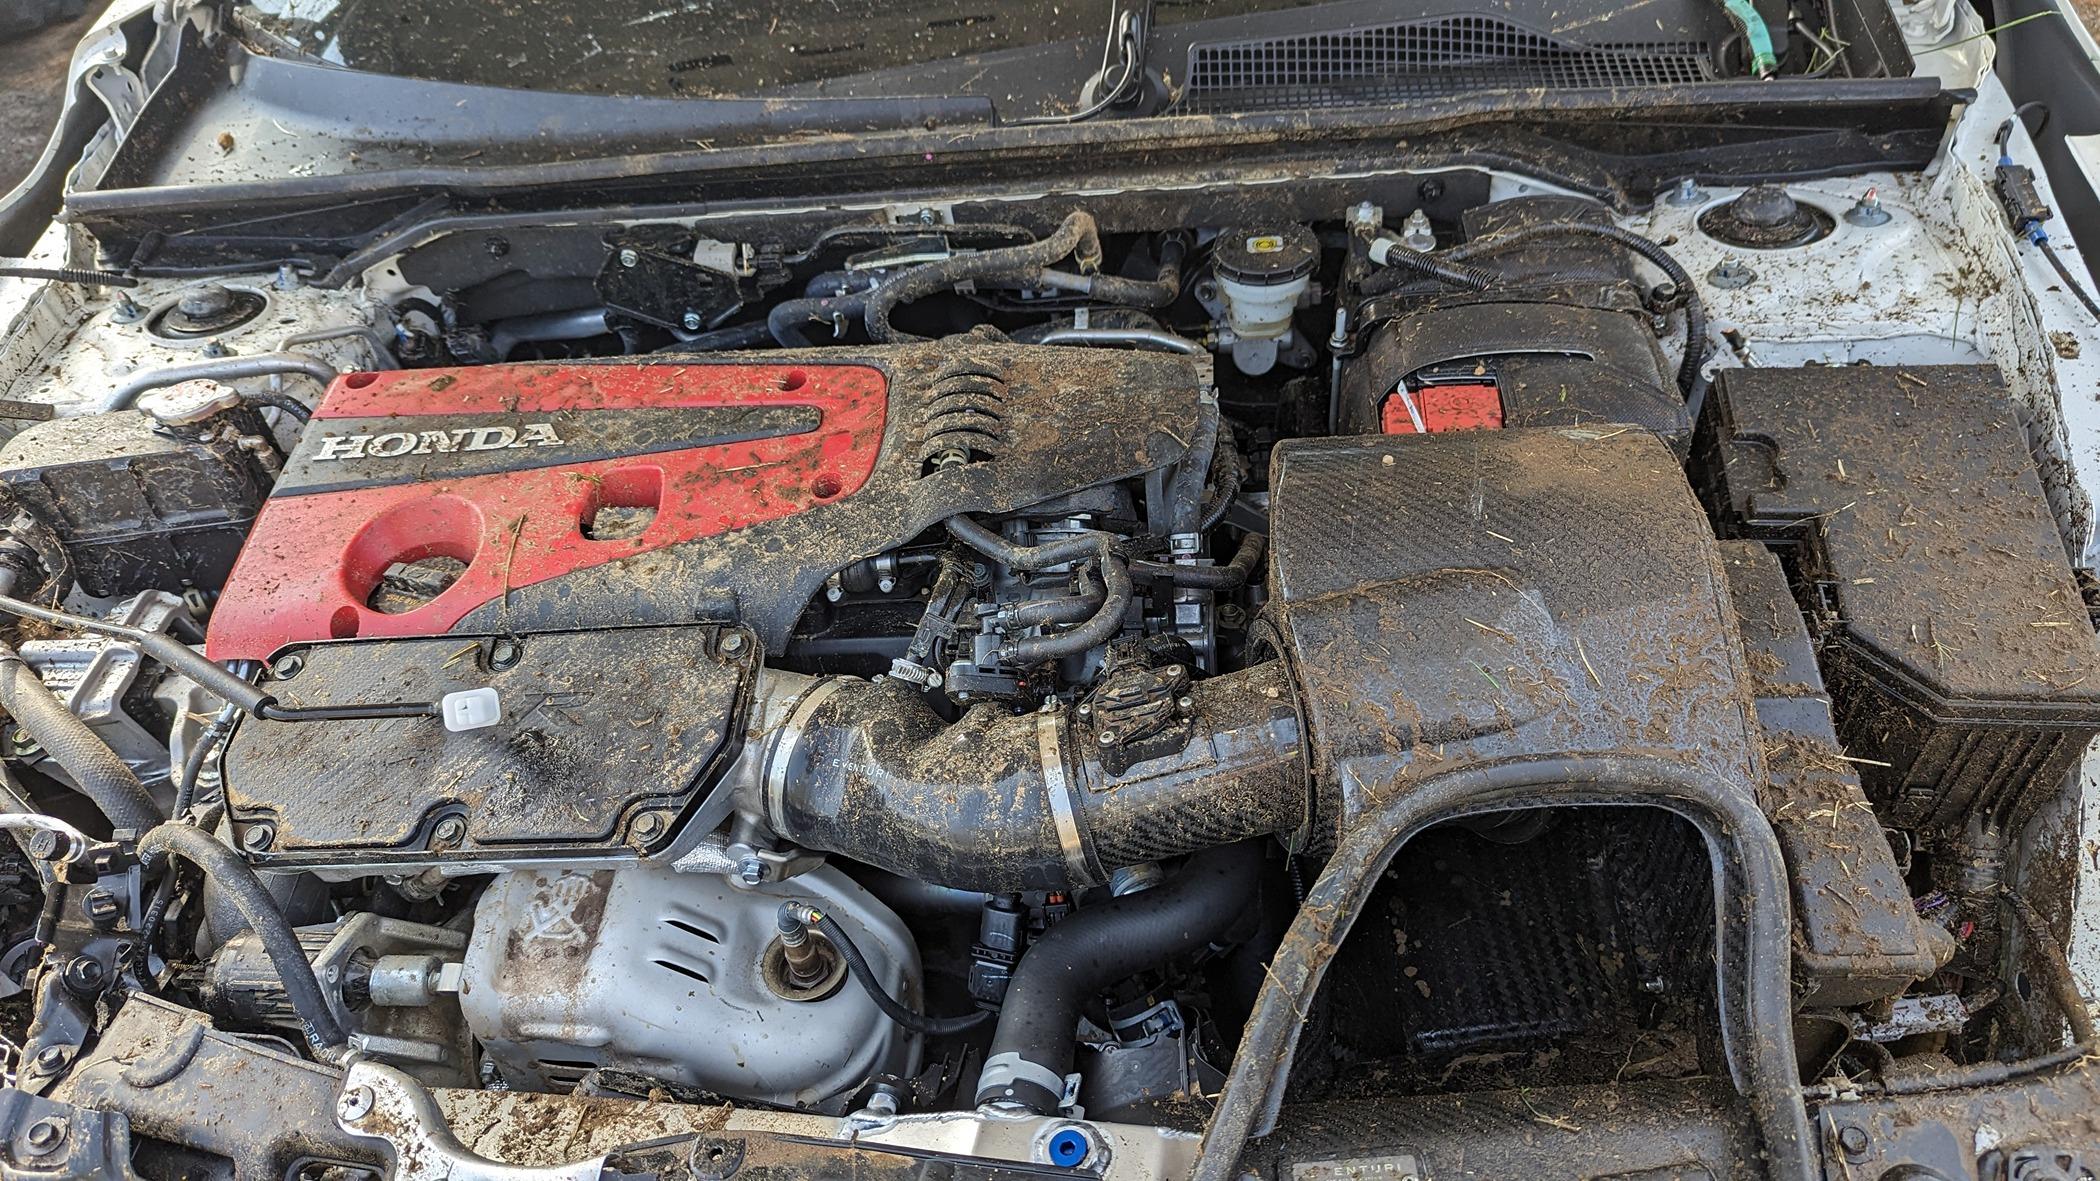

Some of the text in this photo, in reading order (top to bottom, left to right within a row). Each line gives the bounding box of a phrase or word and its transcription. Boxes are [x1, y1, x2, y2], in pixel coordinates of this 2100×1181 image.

[312, 423, 564, 461] HONDA
[832, 758, 889, 780] EVENTURI
[1310, 1163, 1401, 1177] ENTURI
